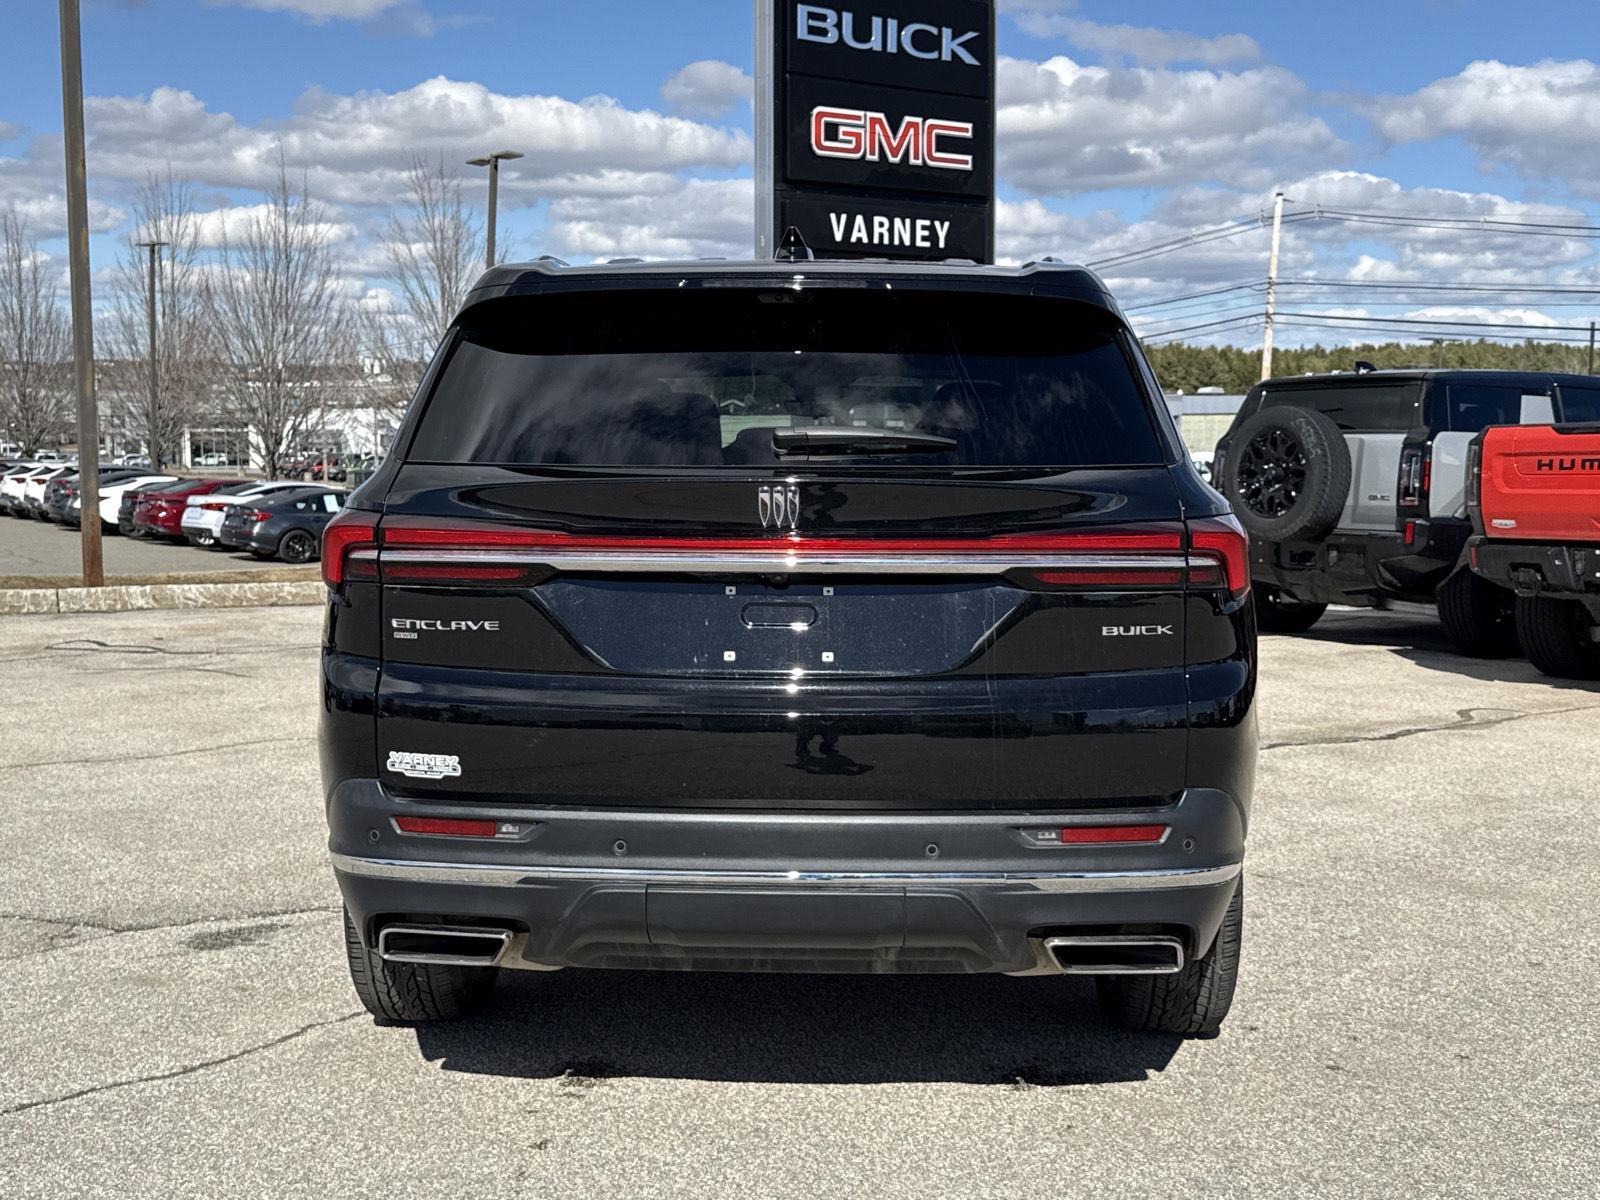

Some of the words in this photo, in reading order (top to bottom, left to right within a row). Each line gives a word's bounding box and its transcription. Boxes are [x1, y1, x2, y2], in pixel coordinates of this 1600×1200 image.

[797, 3, 981, 66] BUICK
[811, 106, 973, 170] GMC
[830, 213, 950, 248] VARNEY
[391, 618, 500, 631] ENCLAVE
[1102, 625, 1174, 636] BUICK
[391, 752, 458, 767] VARNEY
